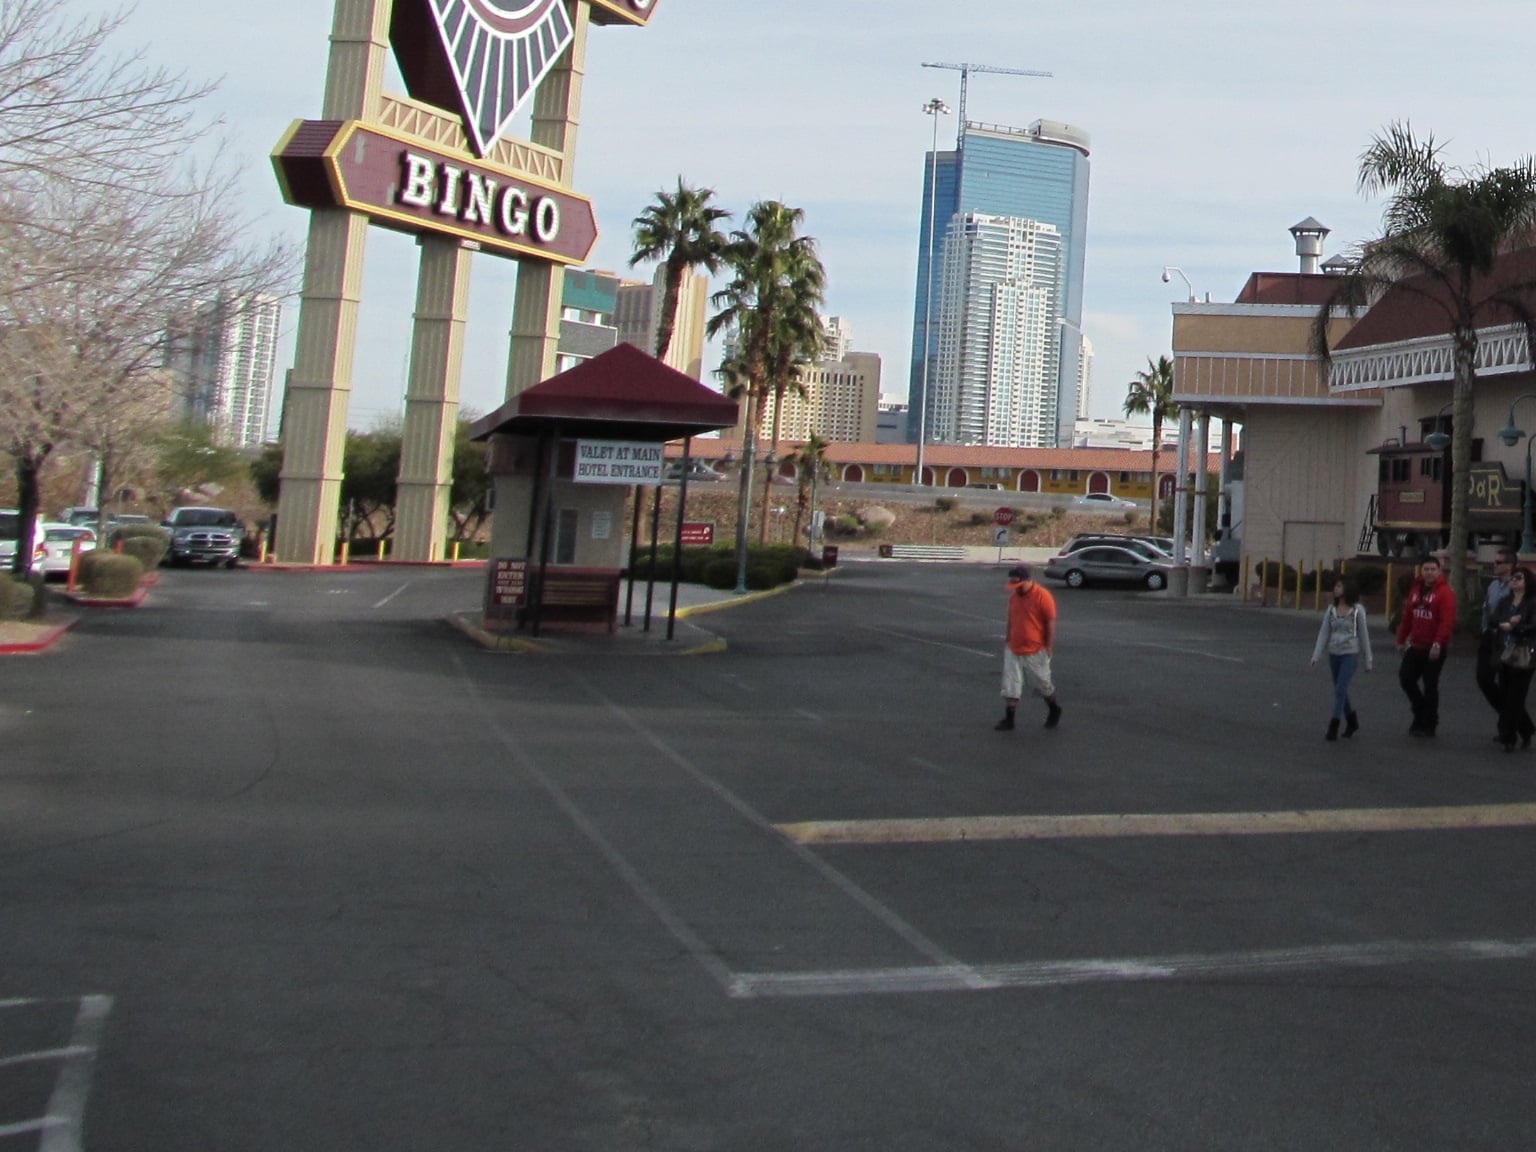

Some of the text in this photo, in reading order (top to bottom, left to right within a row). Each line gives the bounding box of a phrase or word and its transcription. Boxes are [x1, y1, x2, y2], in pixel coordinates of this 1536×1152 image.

[401, 151, 561, 244] BINGO
[580, 445, 661, 461] VALET AT MAIN
[578, 463, 660, 478] HOTEL ENTRANCE
[996, 512, 1013, 521] STOP
[497, 561, 527, 570] DO NOT
[497, 571, 525, 579] ENTER
